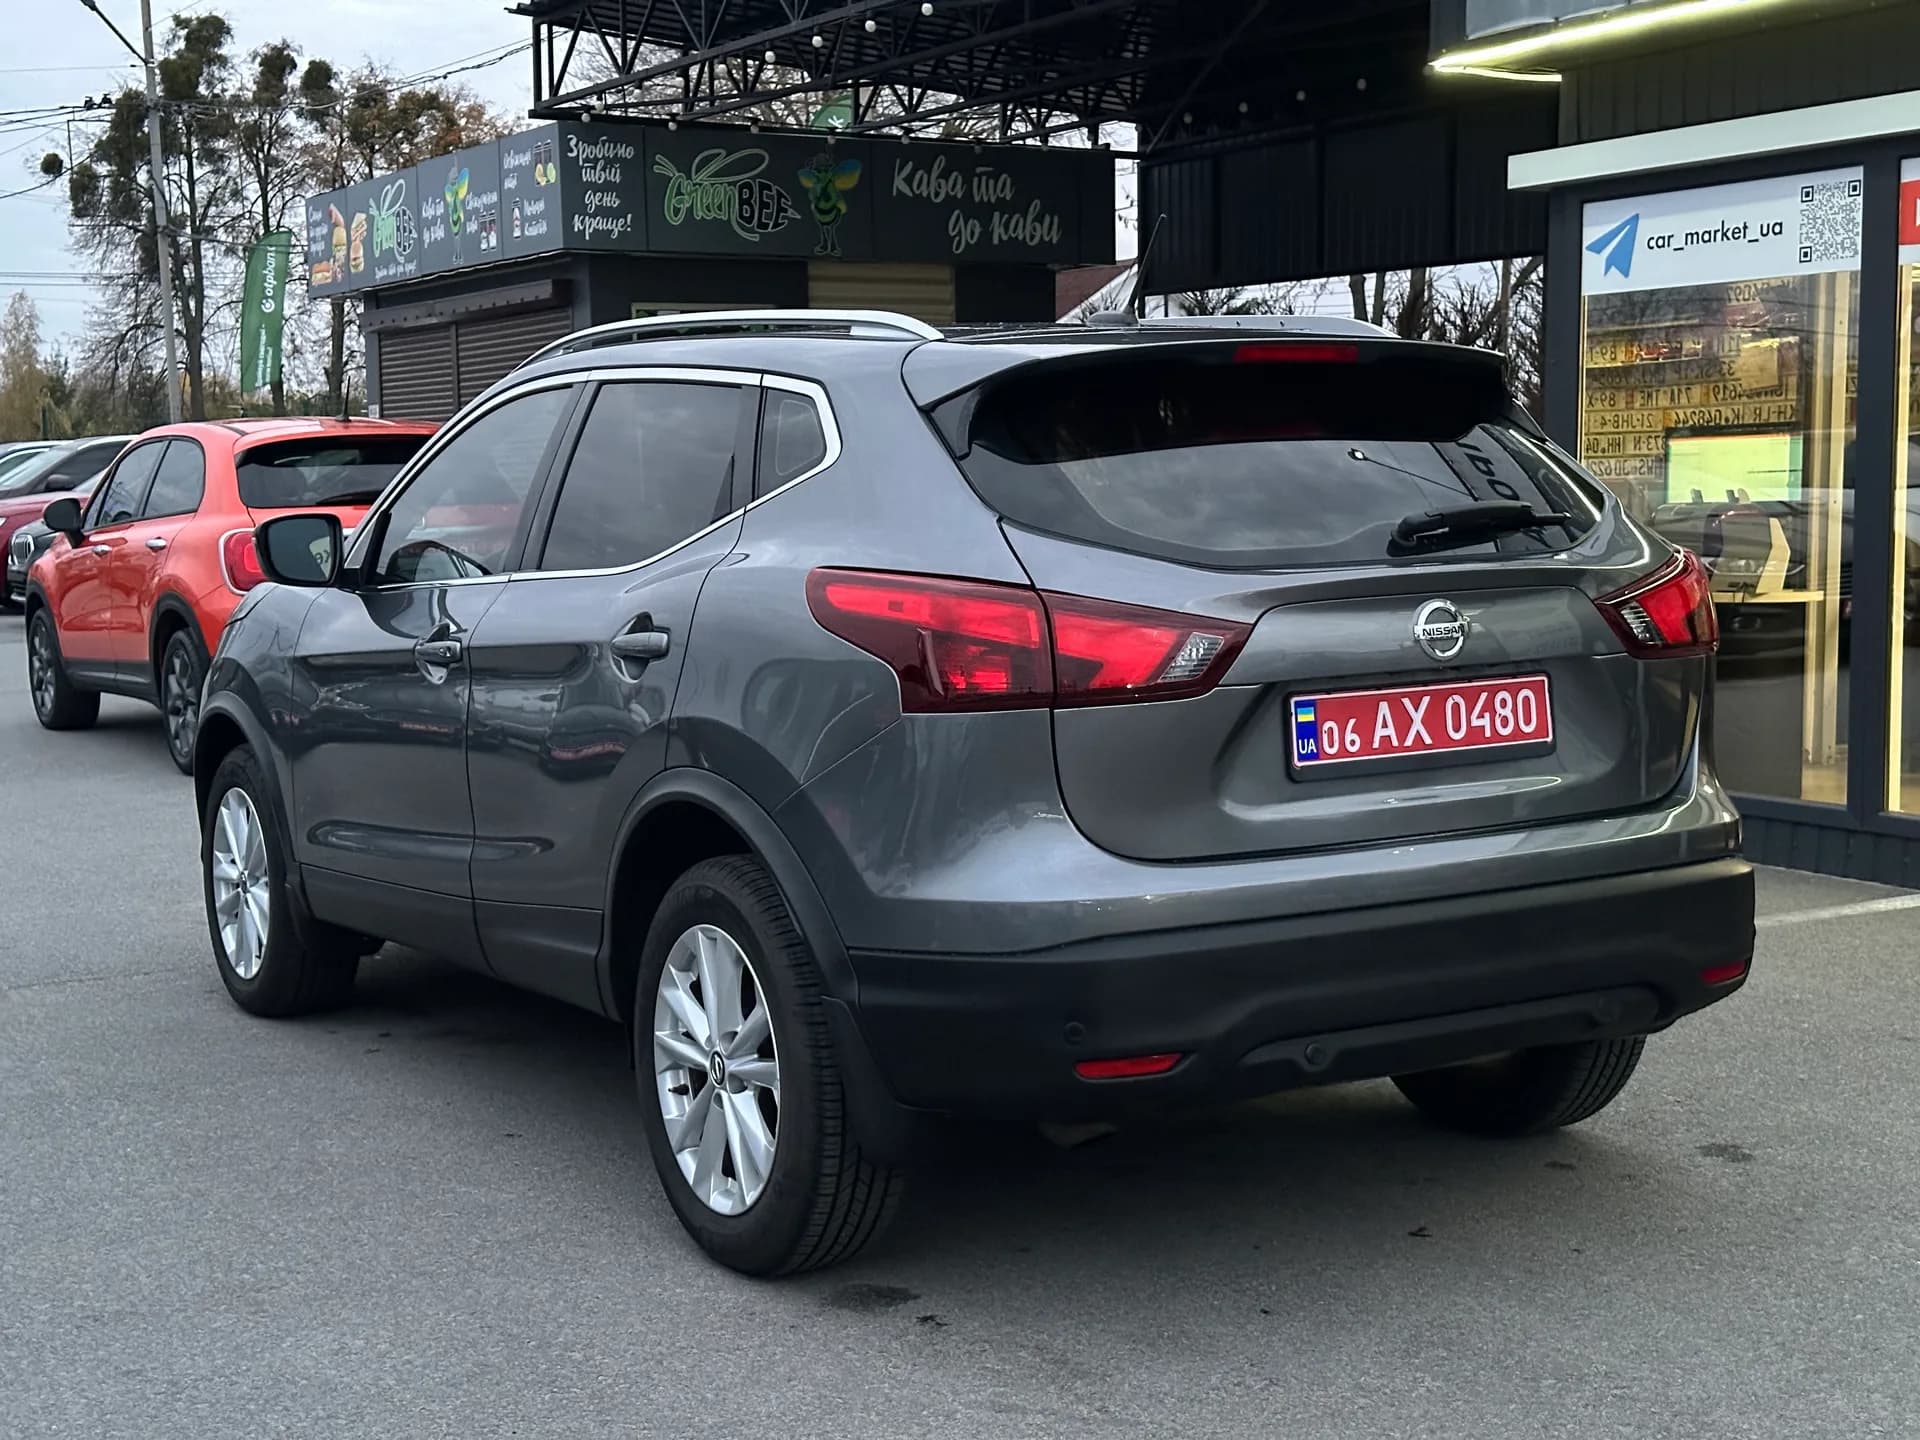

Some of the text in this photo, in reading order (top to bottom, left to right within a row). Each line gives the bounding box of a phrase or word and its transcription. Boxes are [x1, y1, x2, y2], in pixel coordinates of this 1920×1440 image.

[567, 134, 634, 166] Зробимо
[581, 159, 622, 184] твій
[892, 155, 1016, 203] Кава та
[584, 189, 621, 213] день
[572, 213, 632, 240] краще!
[948, 199, 1063, 254] до кави
[1647, 219, 1784, 251] car_market_ua
[1422, 624, 1465, 637] NISSAN
[1322, 688, 1537, 755] 06 AX 0480
[1299, 739, 1317, 755] UA
